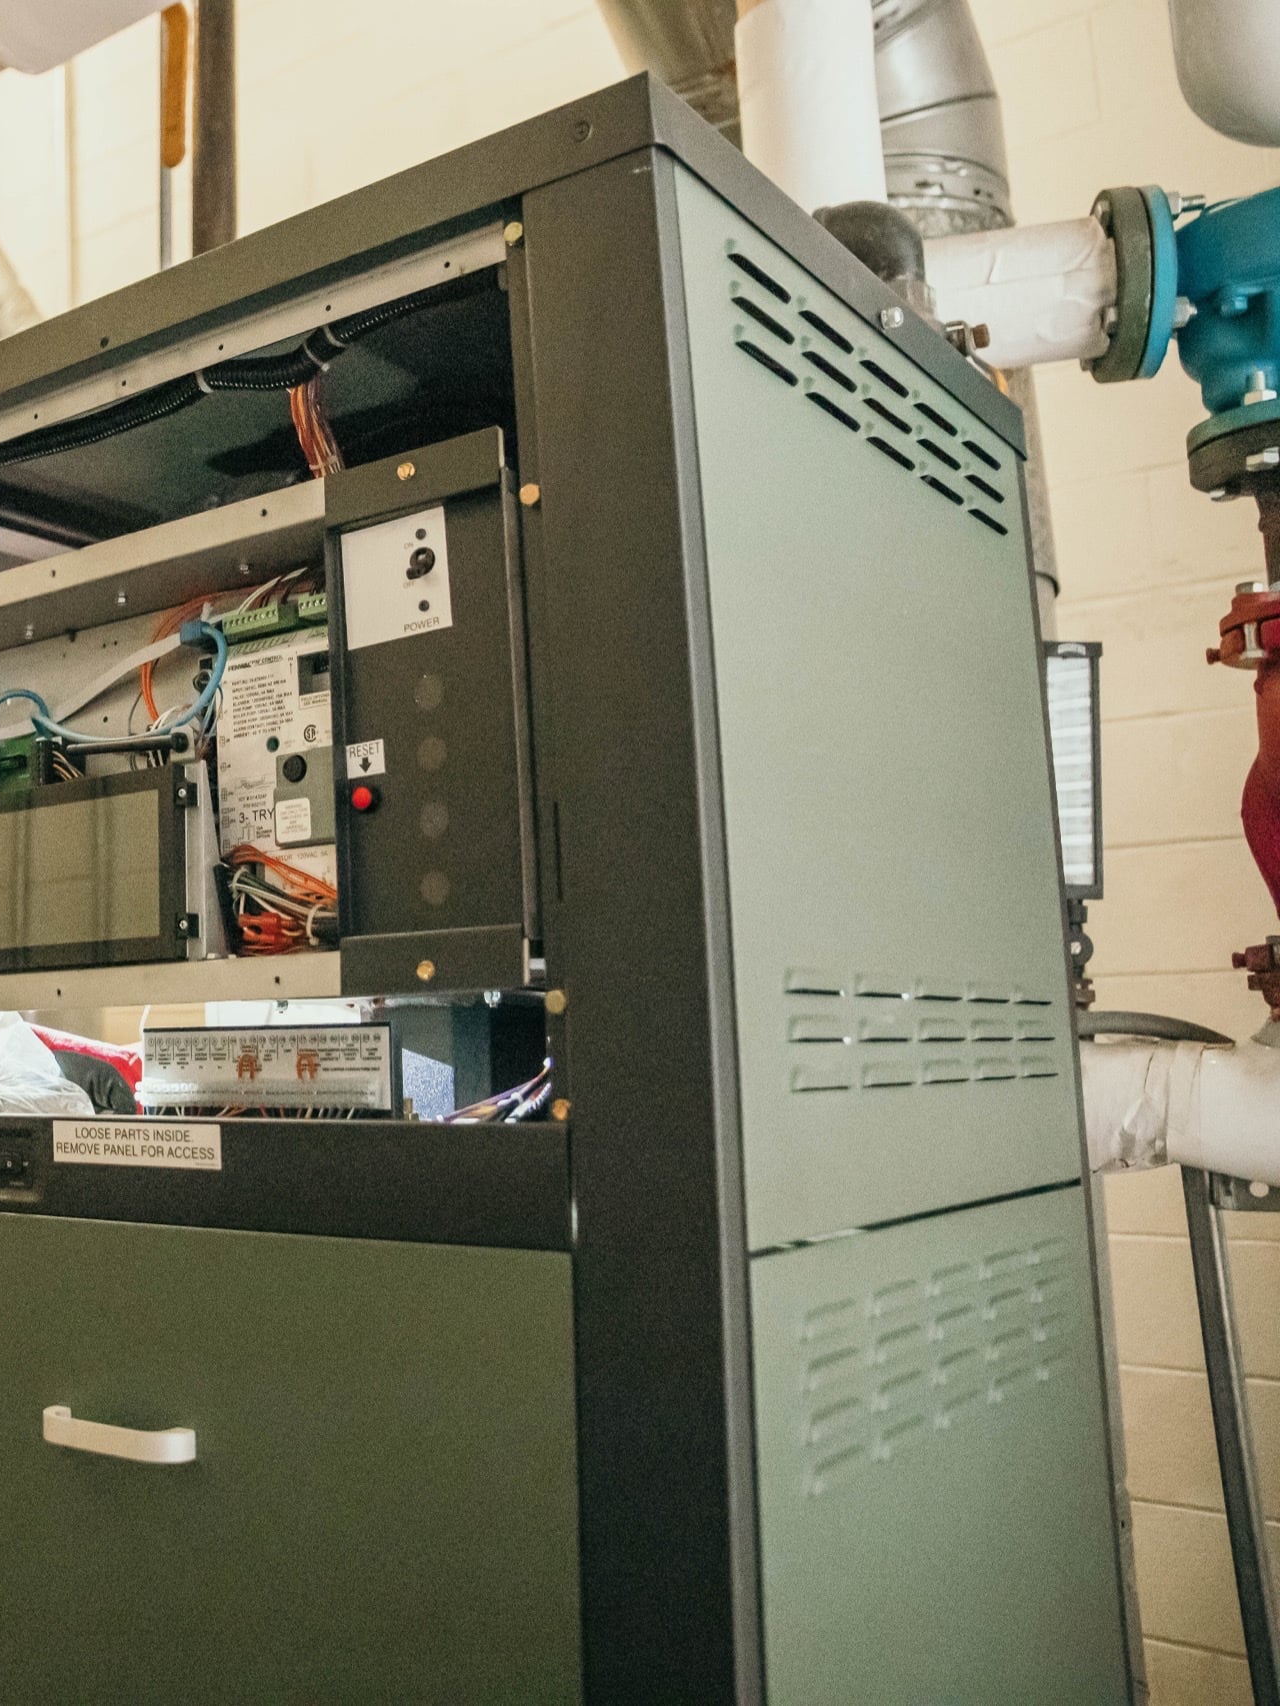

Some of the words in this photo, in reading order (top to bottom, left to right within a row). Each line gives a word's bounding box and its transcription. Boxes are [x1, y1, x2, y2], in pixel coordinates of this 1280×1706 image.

[404, 617, 439, 632] POWER
[349, 742, 380, 758] RESET
[253, 808, 275, 821] TRY
[75, 1127, 110, 1140] LOOSE
[115, 1128, 150, 1141] PARTS
[56, 1142, 100, 1155] REMOVE
[103, 1144, 138, 1157] PANEL
[141, 1145, 164, 1158] FOR
